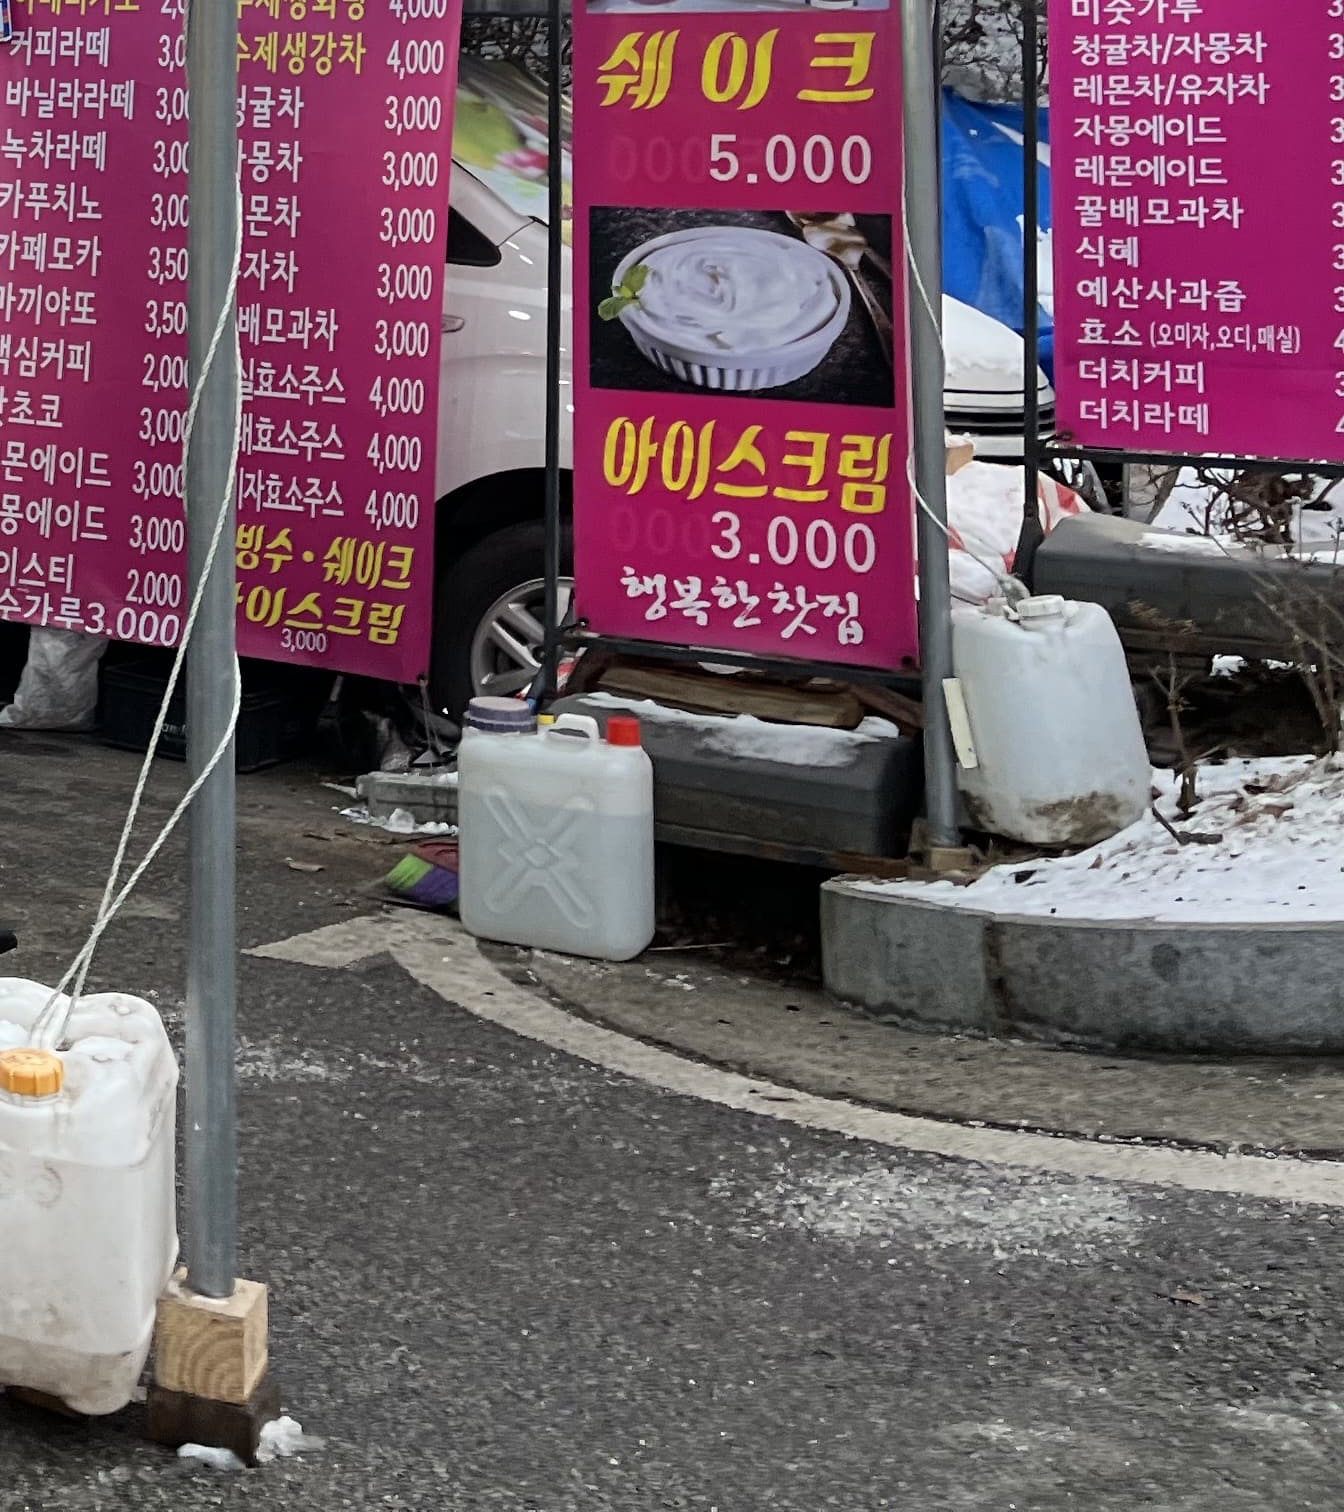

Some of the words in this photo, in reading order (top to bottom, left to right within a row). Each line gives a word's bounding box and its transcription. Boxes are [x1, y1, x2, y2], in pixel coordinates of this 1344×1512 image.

[11, 26, 111, 68] 커피라떼
[386, 39, 445, 80] 4,000
[1071, 31, 1268, 66] 청귤차/자몽차
[596, 28, 876, 110] 쉐이크
[1073, 72, 1271, 106] 레몬차/유자차
[5, 77, 135, 121] 바닐라라떼
[384, 95, 442, 136] 3,000
[0, 128, 107, 172] 녹차라떼
[1073, 113, 1227, 147] 자몽에이드
[381, 151, 438, 192] 3,000
[709, 133, 872, 185] 5.000
[1074, 154, 1228, 187] 레몬에이드
[245, 195, 302, 238] 몬차
[379, 207, 435, 248] 3,000
[1074, 195, 1245, 229] 꿀배모과차
[1075, 235, 1139, 268] 식혜
[243, 250, 299, 294] 자차
[376, 263, 433, 305] 3,000
[1076, 275, 1247, 313] 예산사과즙
[240, 306, 340, 353] 배모과차
[374, 319, 430, 361] 3,000
[1077, 318, 1143, 346] 효소
[238, 360, 347, 405] 실효소주스
[368, 375, 425, 418] 4,000
[1079, 357, 1204, 394] 더치커피
[1079, 397, 1209, 435] 더치라떼
[366, 432, 422, 474] 4,000
[603, 415, 893, 514] 아이스크림
[364, 489, 419, 531] 4,000
[129, 514, 185, 555] 3,000
[710, 510, 876, 573] 3.000
[84, 602, 180, 647] 3.000
[237, 581, 407, 646] 이스크림
[620, 566, 762, 628] 행복한
[767, 581, 864, 645] 찻집
[280, 627, 327, 653] 3,000
